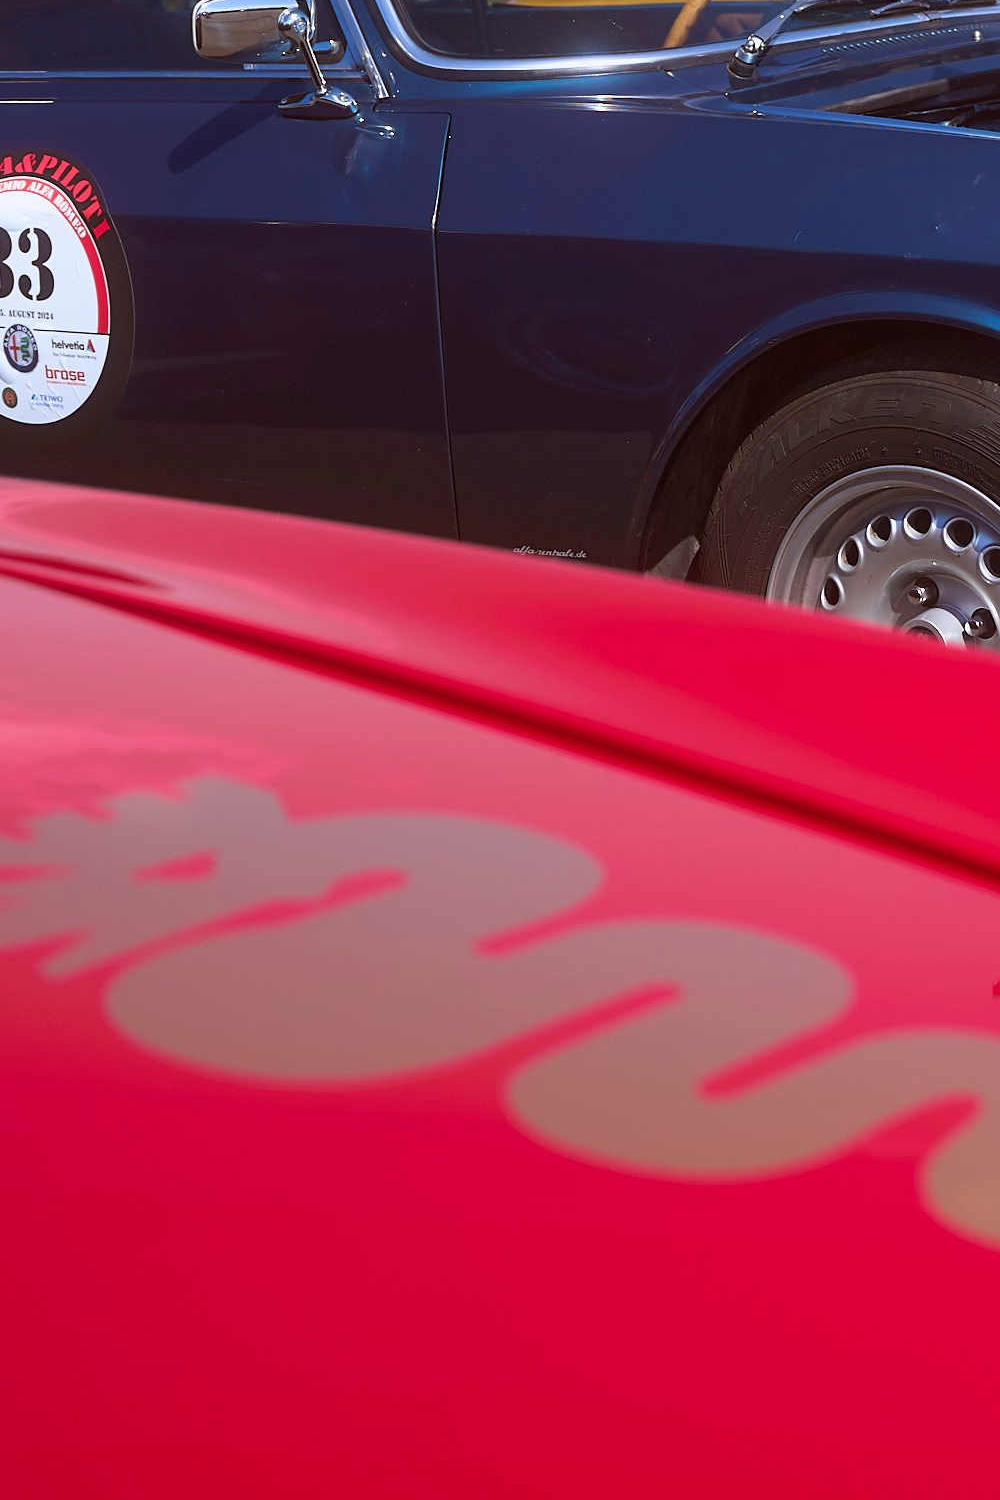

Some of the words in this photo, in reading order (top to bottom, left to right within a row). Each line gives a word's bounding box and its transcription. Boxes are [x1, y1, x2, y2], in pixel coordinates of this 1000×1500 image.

[27, 181, 55, 200] ALFA
[53, 195, 87, 238] ROMEO
[8, 310, 35, 318] AUGUST
[37, 311, 54, 320] 2024
[51, 339, 85, 351] helvetia
[44, 365, 85, 382] brose
[40, 394, 64, 403] TRIWO
